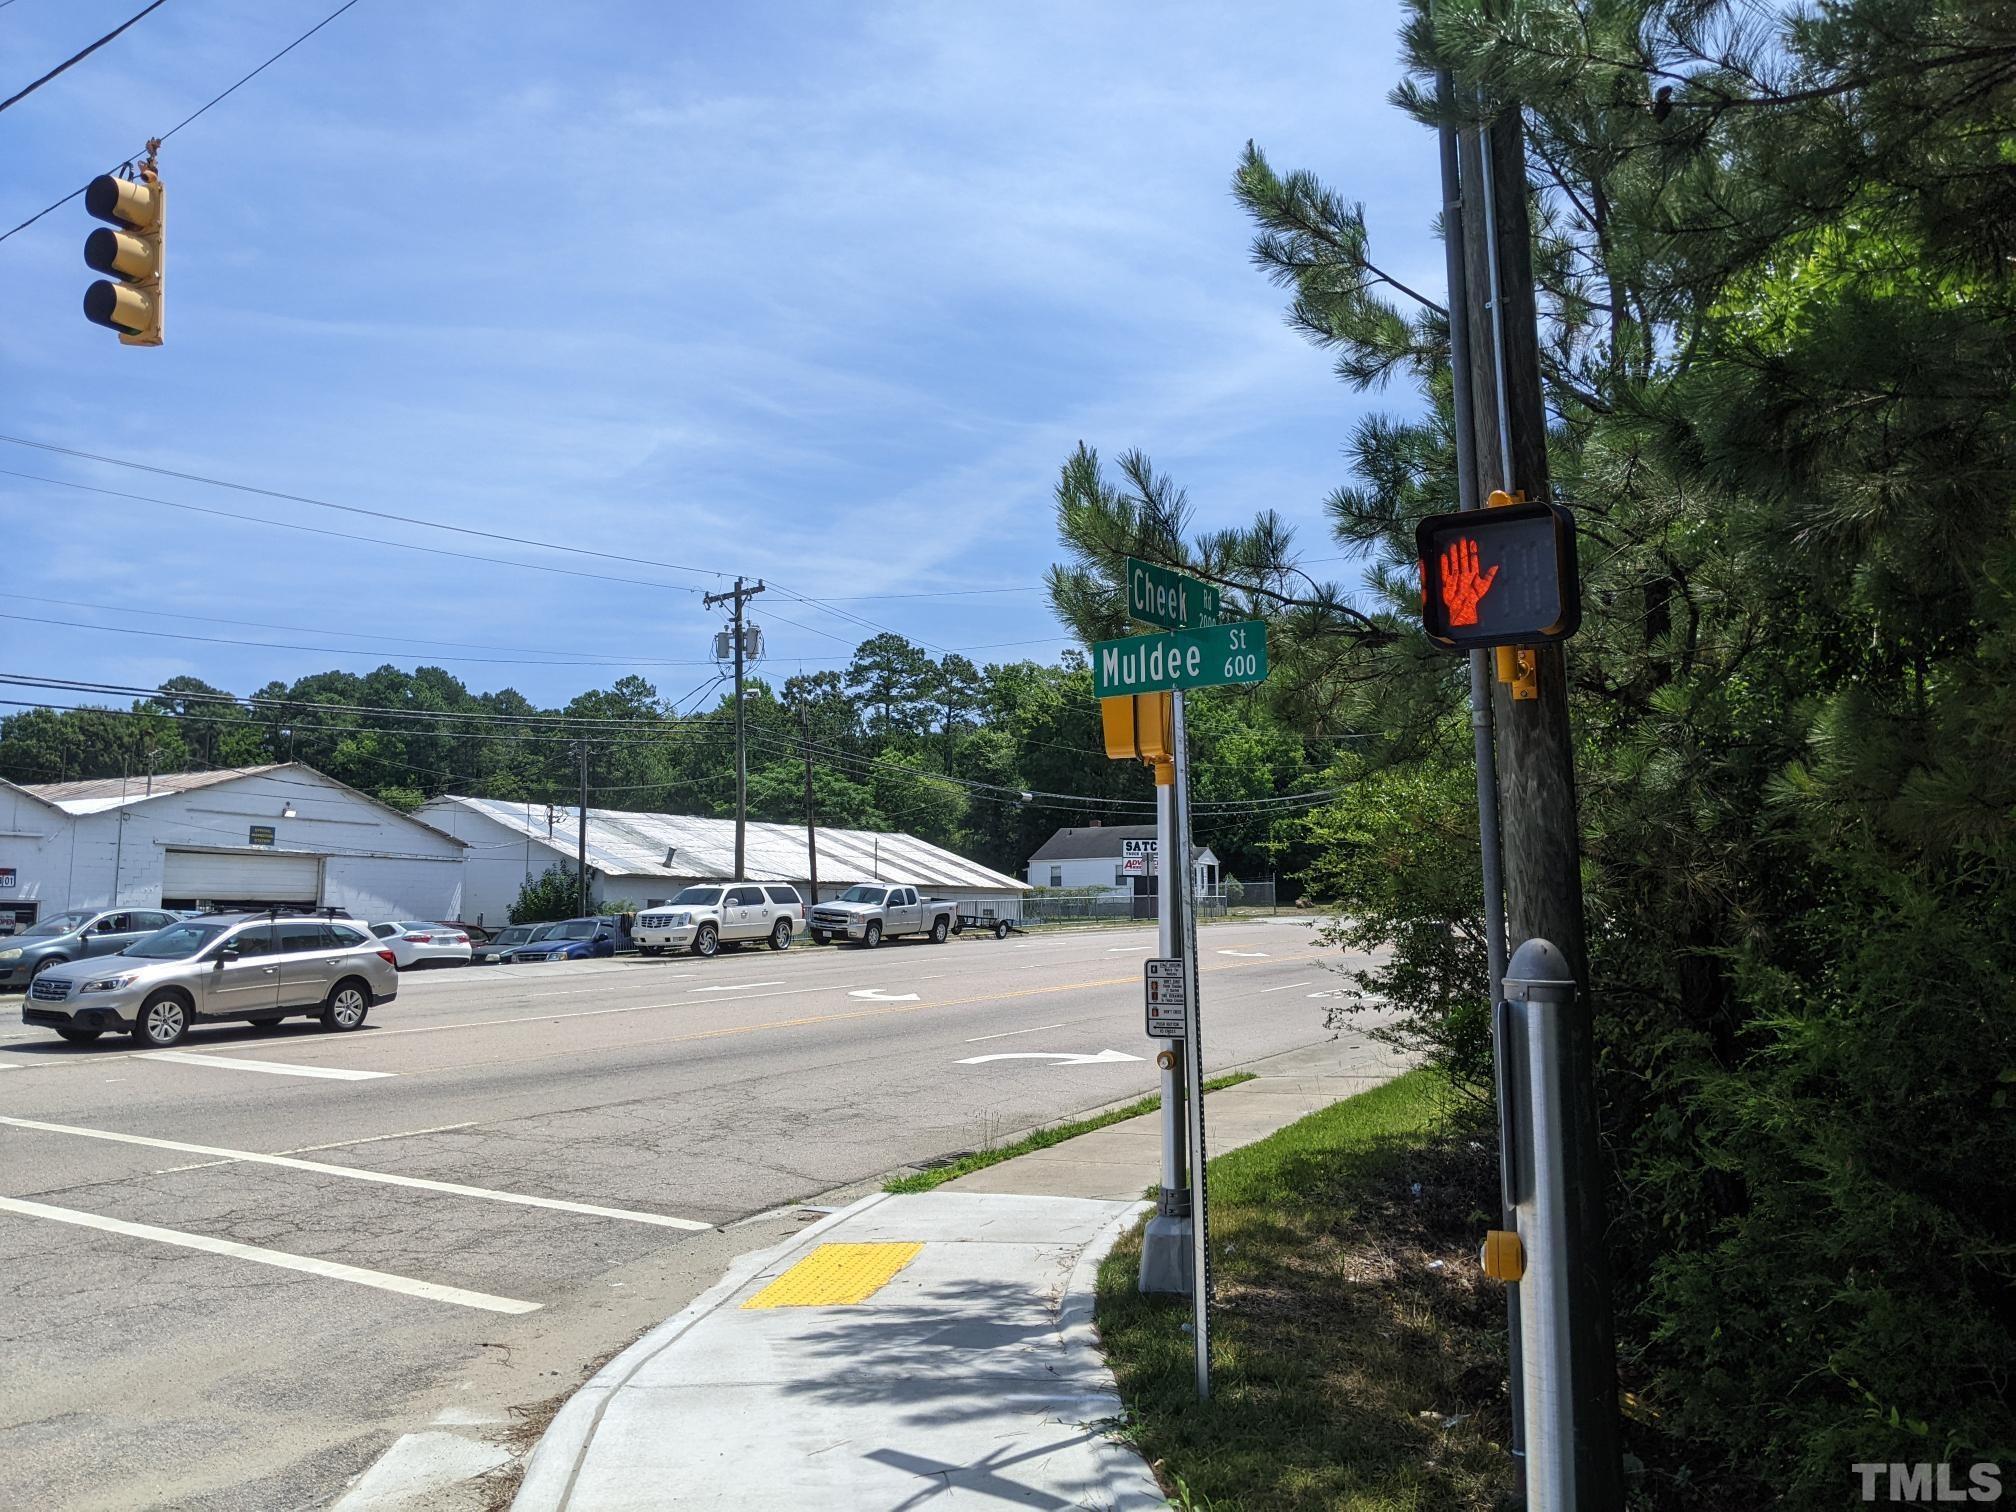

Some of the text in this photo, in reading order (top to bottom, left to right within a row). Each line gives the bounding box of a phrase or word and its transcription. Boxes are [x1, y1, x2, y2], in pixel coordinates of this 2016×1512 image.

[1134, 568, 1212, 622] Cheek Rd
[1103, 628, 1246, 688] Muldee St
[1224, 654, 1256, 678] 600
[1126, 841, 1157, 851] SATC
